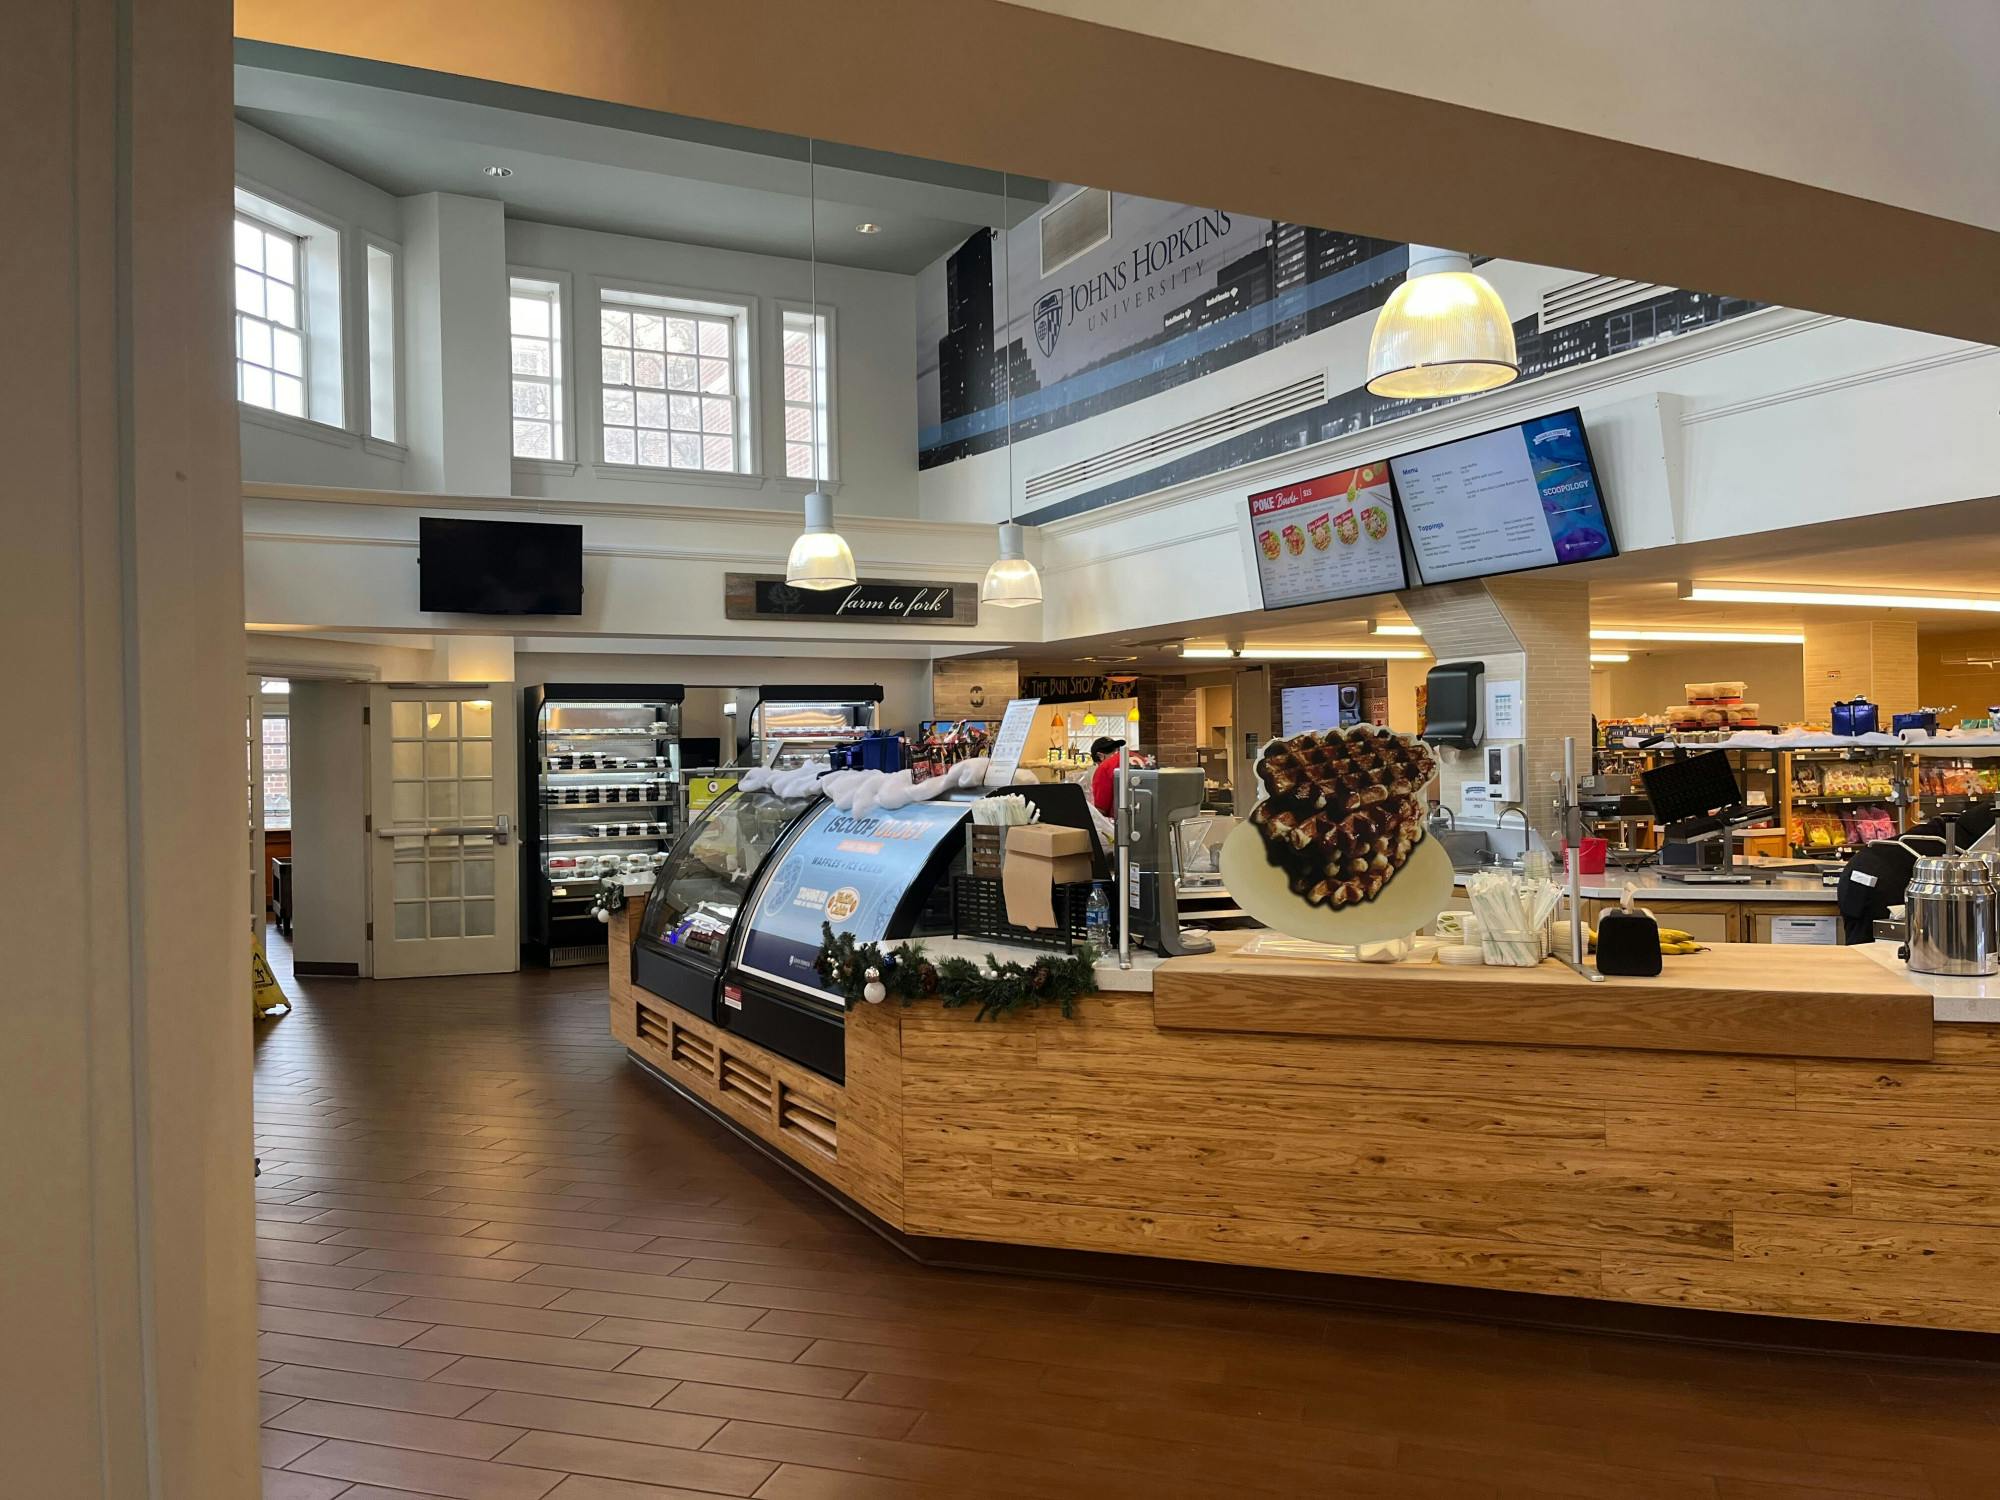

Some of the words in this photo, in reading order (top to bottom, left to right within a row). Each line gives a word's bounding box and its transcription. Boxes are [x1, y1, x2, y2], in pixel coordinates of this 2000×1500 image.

[1068, 262, 1127, 326] JOHNS
[1133, 209, 1231, 283] HOPKINS
[1088, 259, 1205, 332] UNIVERSITY
[1402, 467, 1419, 476] Menu
[1542, 480, 1590, 496] SCOOPOLOGY
[1252, 496, 1275, 513] POKE
[1276, 491, 1299, 509] Bowls
[1417, 522, 1444, 532] Toppings
[836, 585, 884, 616] farm
[888, 596, 904, 611] to
[903, 587, 949, 617] fork
[1032, 680, 1048, 697] THE
[1050, 678, 1068, 696] BUN
[1070, 676, 1096, 695] SHOP
[811, 855, 839, 869] WAFFLES
